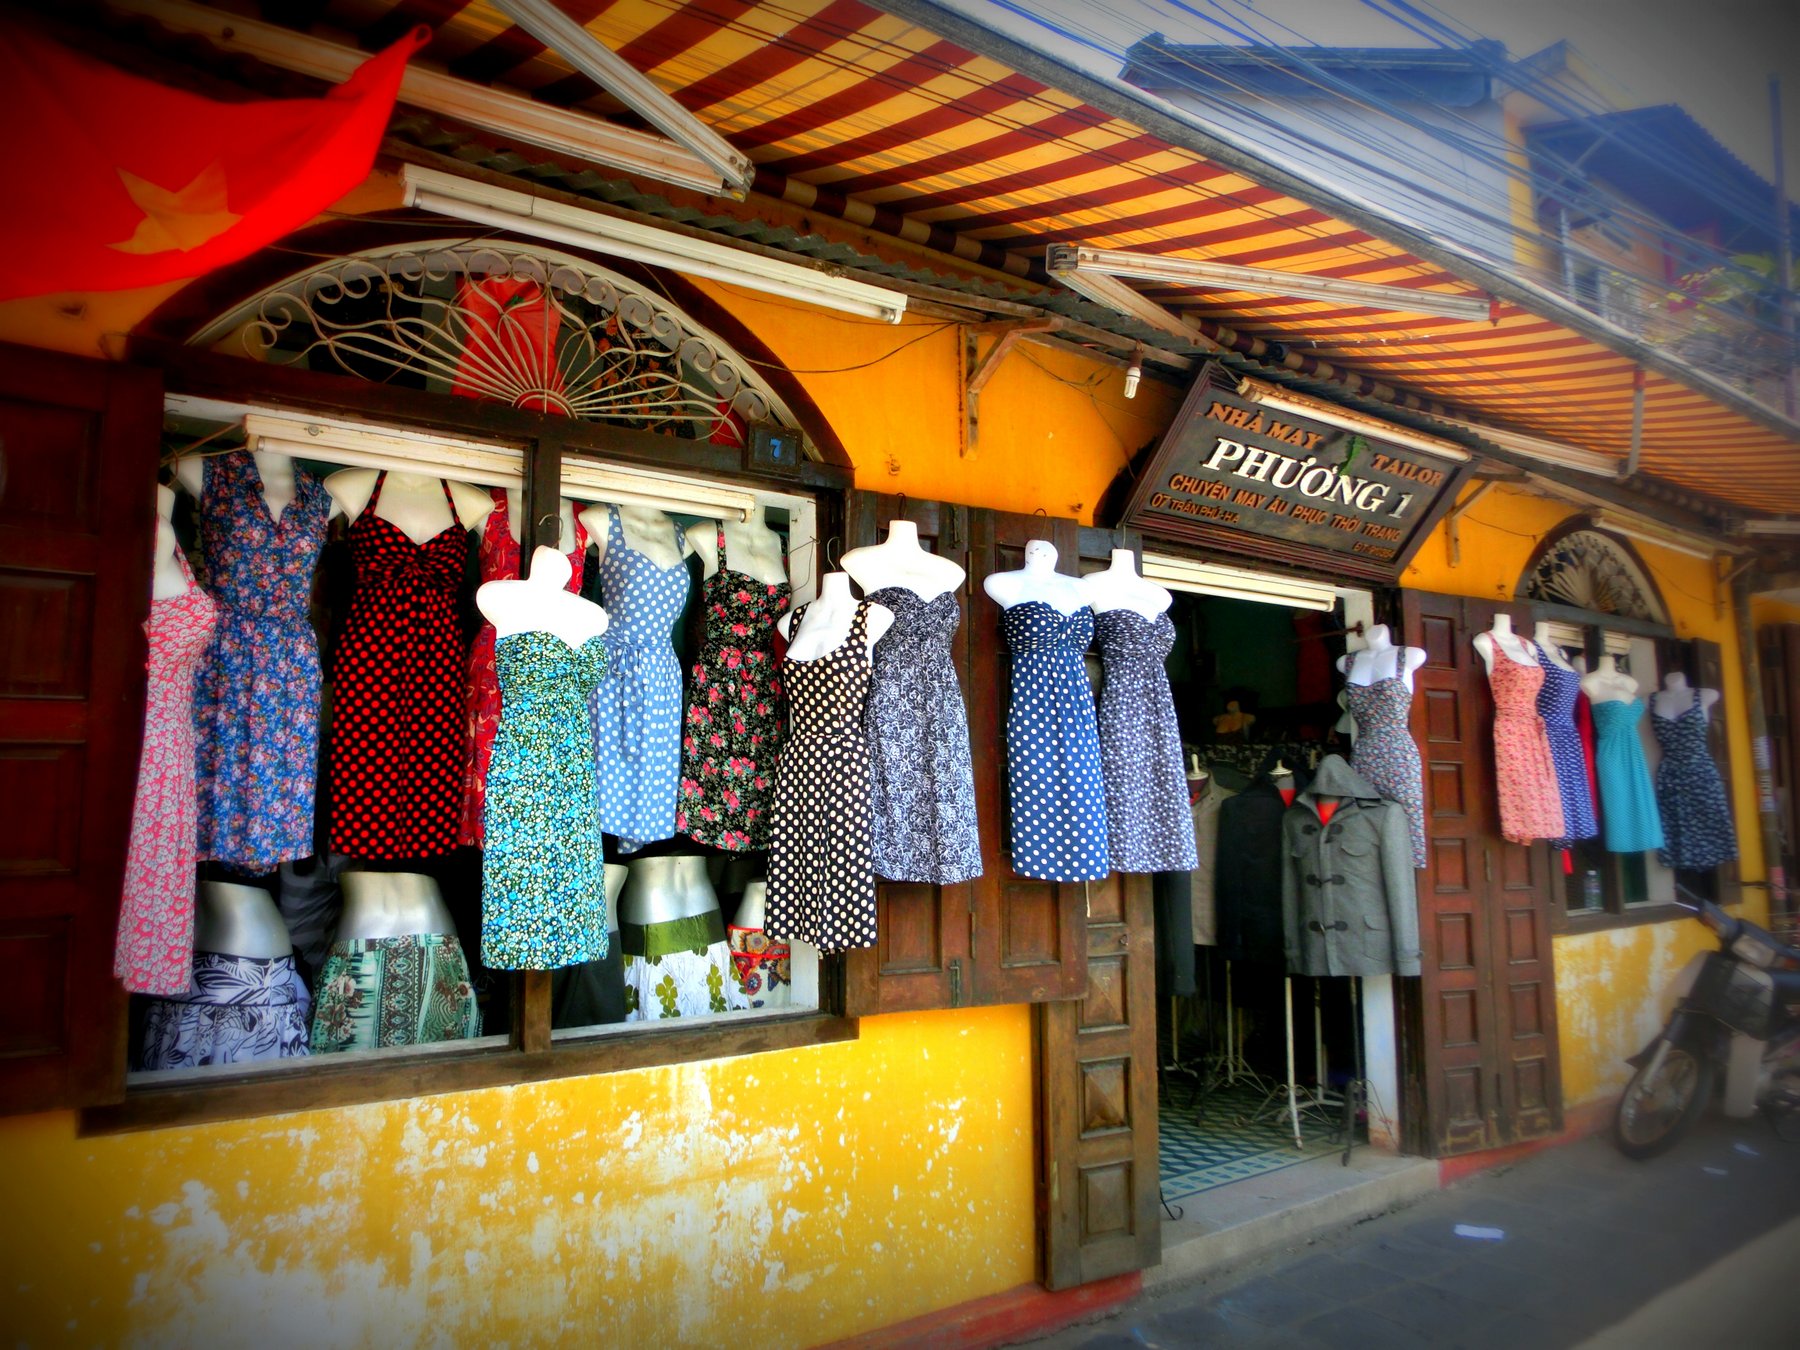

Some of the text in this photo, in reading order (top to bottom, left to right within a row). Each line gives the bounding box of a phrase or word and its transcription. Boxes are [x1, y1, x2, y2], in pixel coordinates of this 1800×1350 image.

[769, 437, 782, 458] 7
[1266, 420, 1324, 450] MAY
[1371, 453, 1444, 487] TAILOR
[1202, 437, 1413, 519] PHƯƠNG 1
[1233, 489, 1267, 510] MAY
[1362, 523, 1402, 542] TRANG
